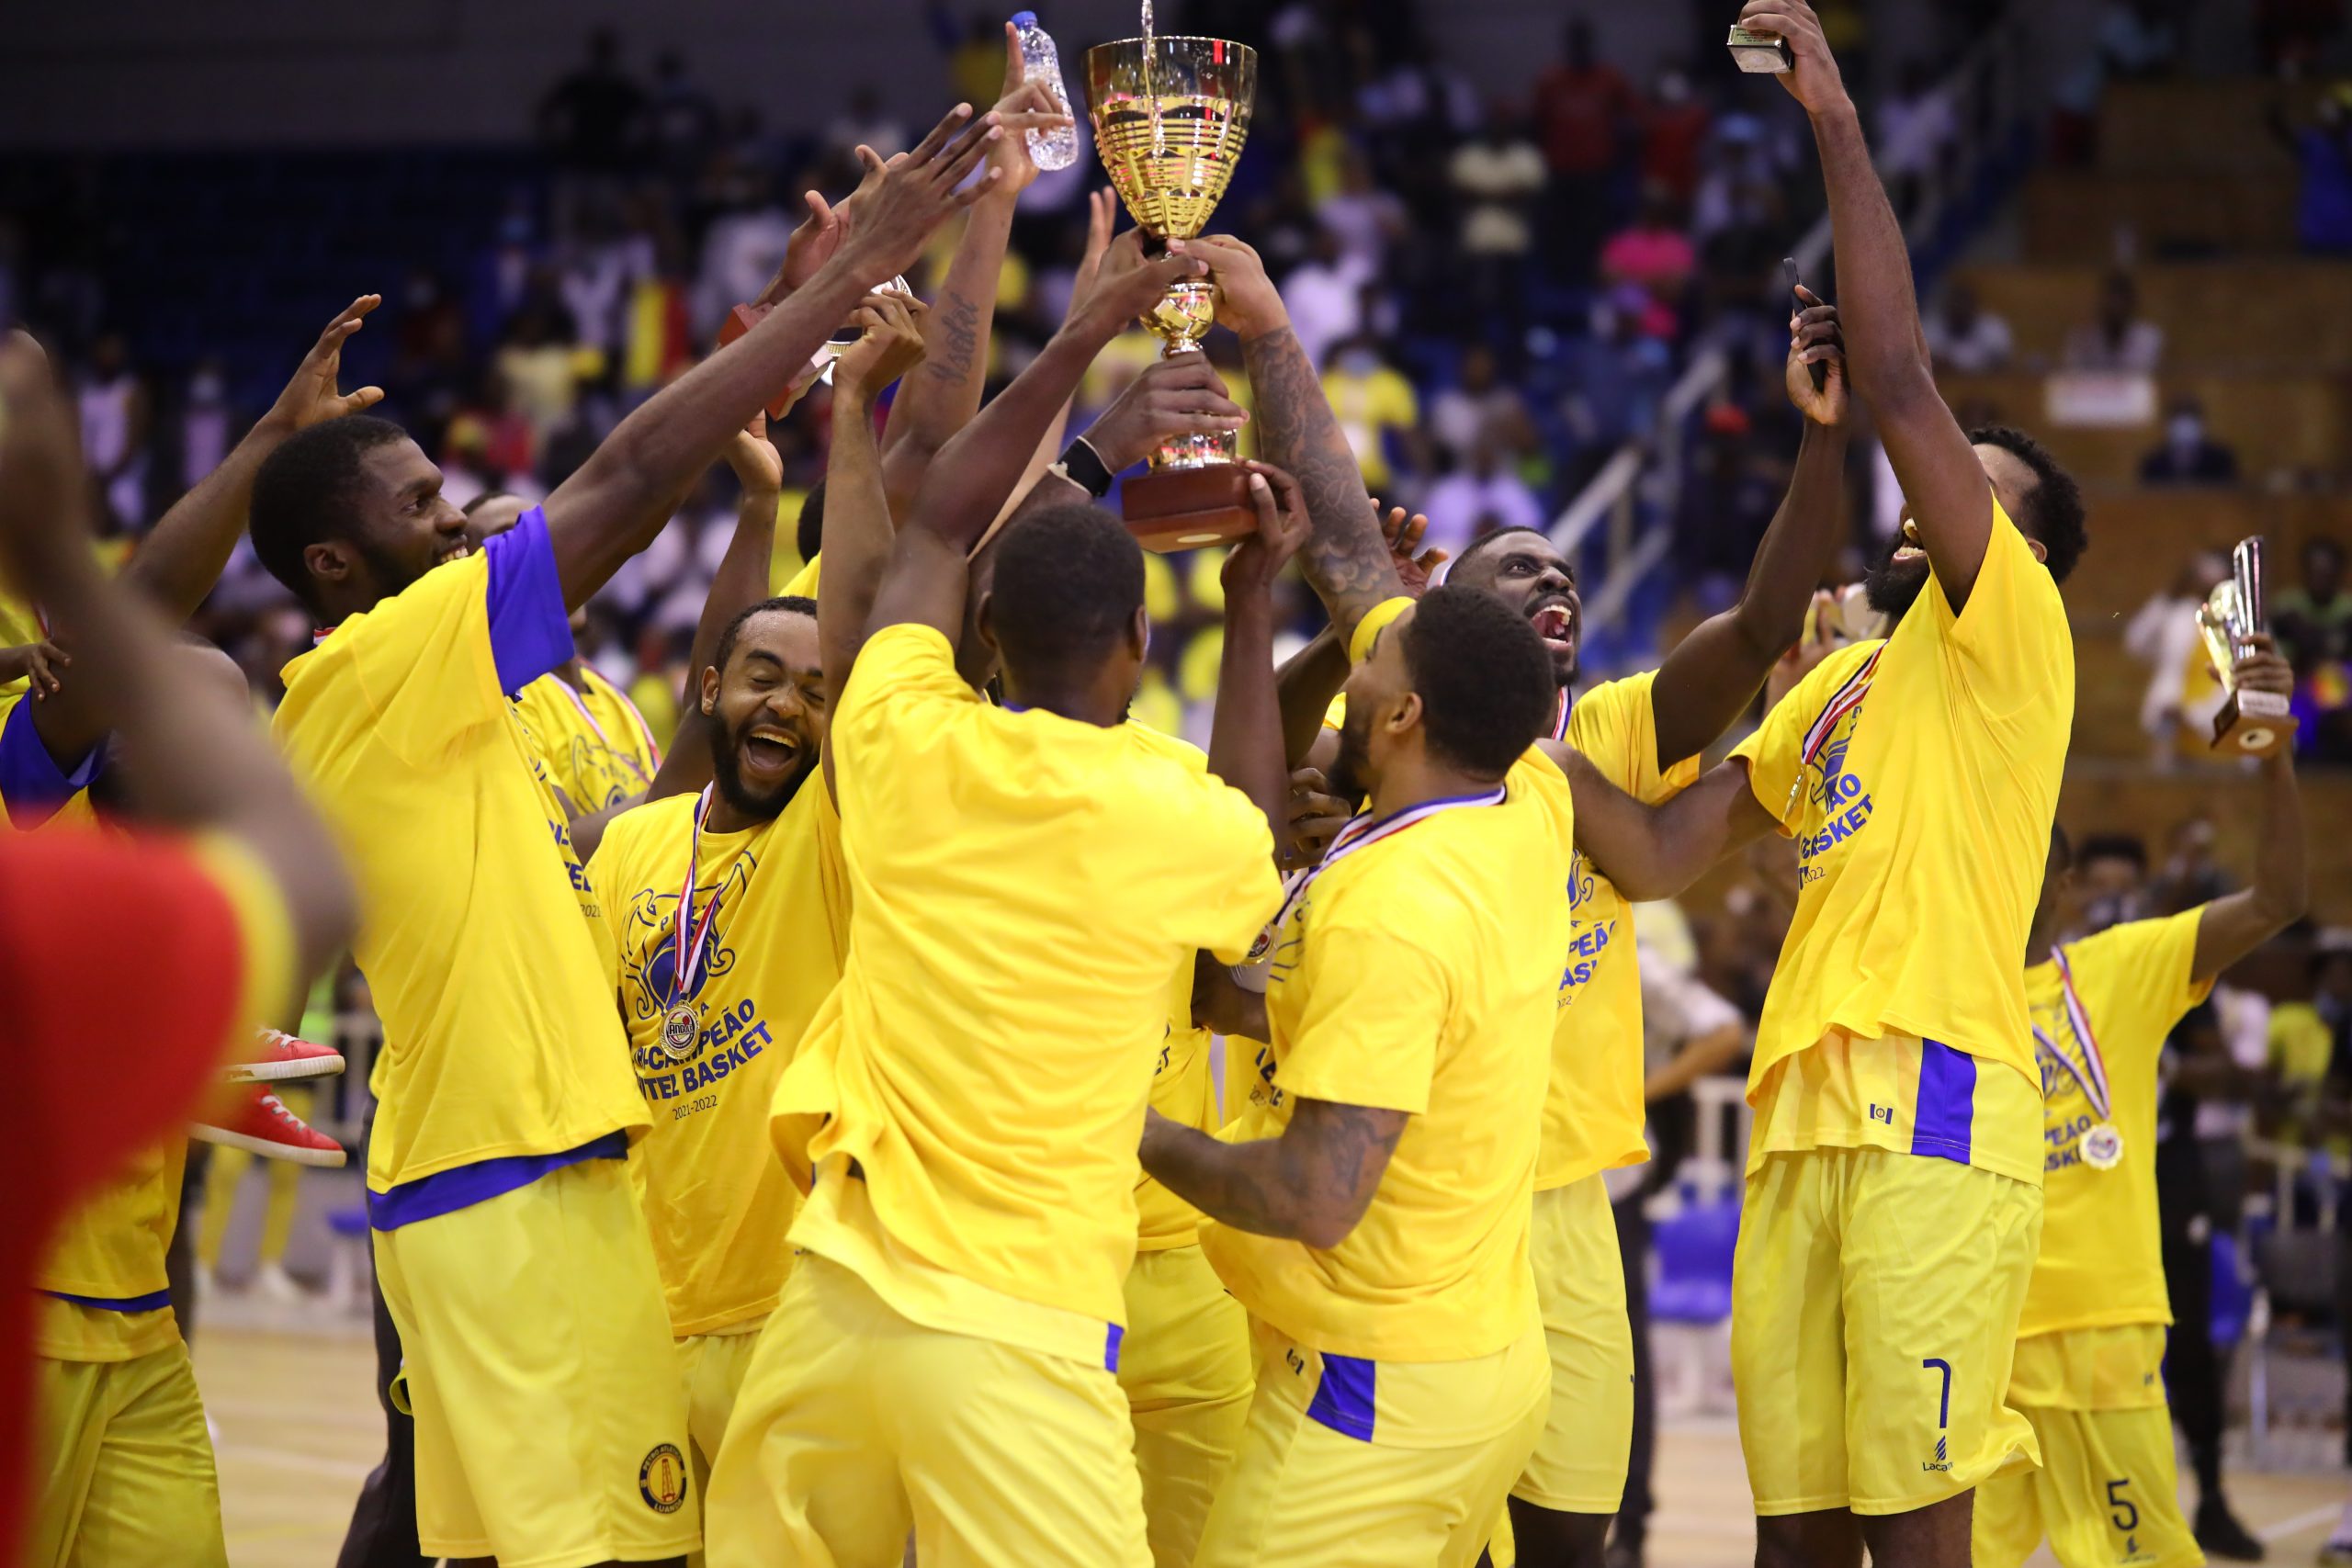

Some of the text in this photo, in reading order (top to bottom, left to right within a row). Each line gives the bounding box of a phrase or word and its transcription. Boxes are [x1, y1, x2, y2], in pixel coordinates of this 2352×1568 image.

[684, 1020, 774, 1090] BASKET
[673, 1094, 718, 1121] 2021-2022
[1922, 1358, 1951, 1428] 7
[2106, 1478, 2139, 1531] 5
